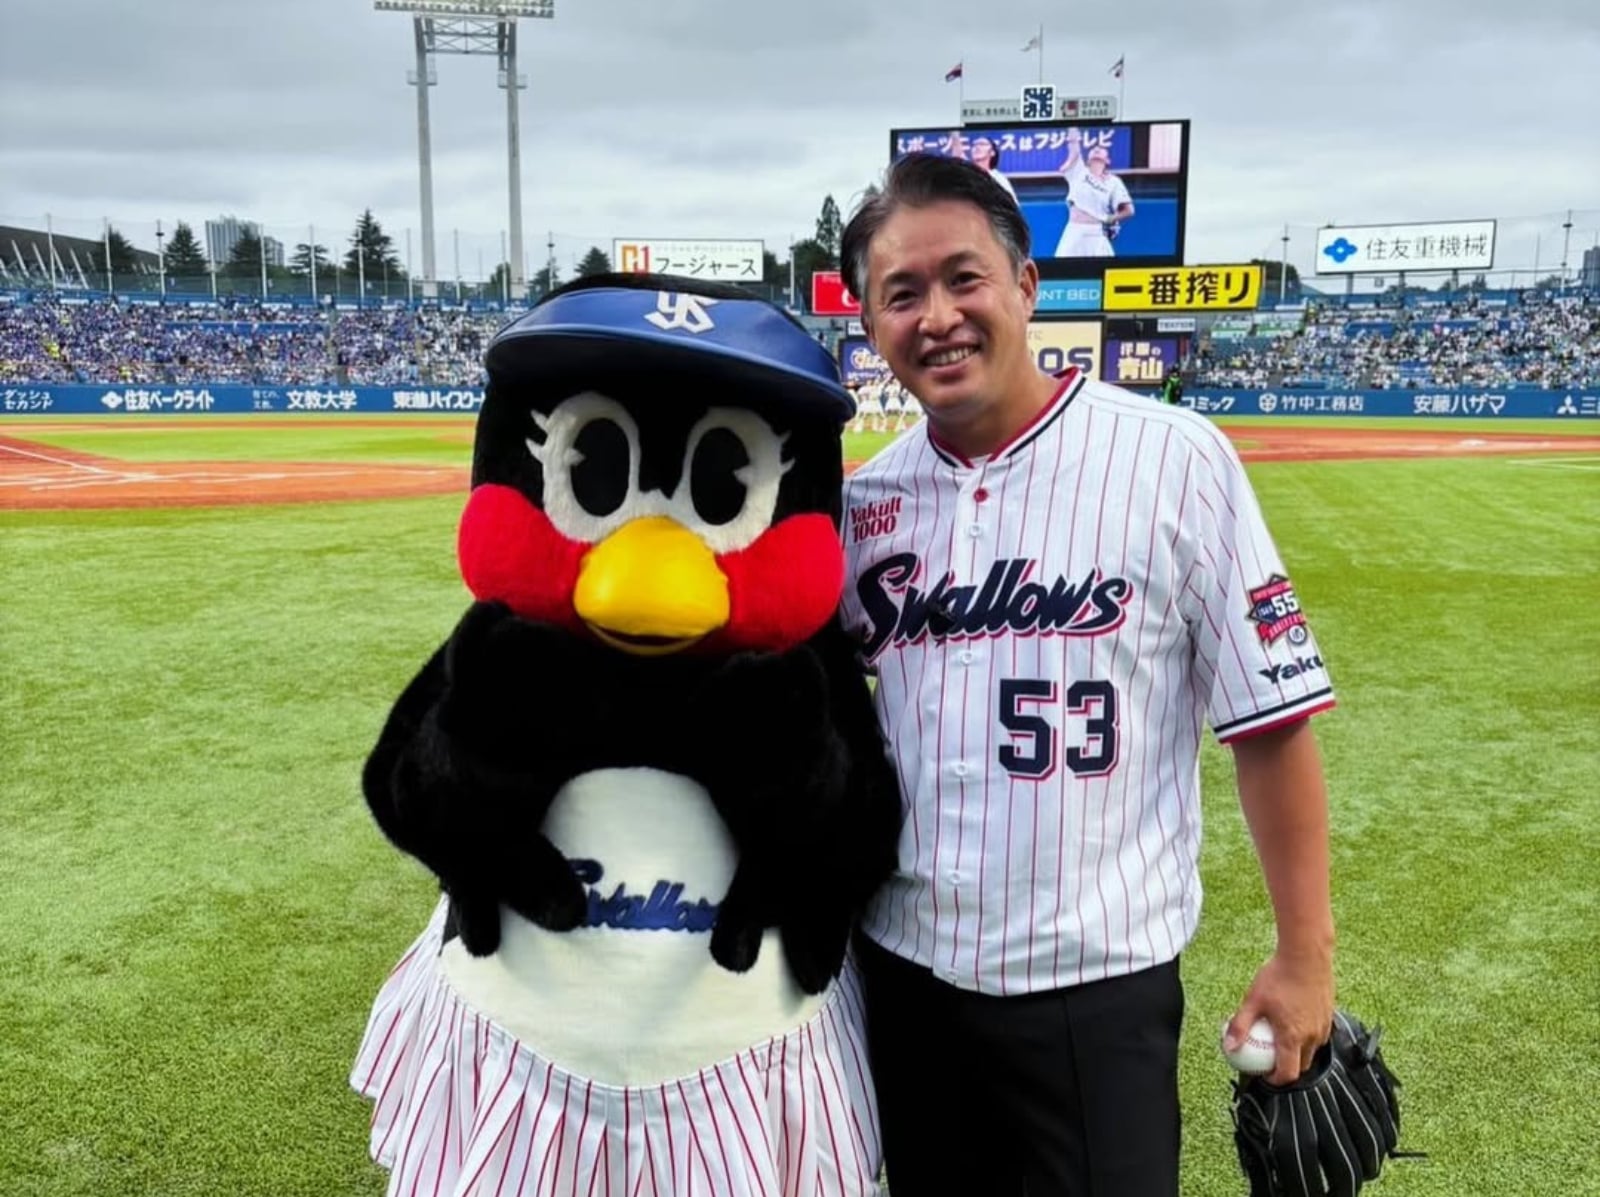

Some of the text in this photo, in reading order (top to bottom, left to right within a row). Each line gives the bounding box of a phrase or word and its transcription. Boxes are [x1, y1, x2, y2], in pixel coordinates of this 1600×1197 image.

[1366, 234, 1487, 260] 住友重機械
[655, 254, 757, 275] フージャース
[1113, 270, 1250, 305] 一番搾り
[1117, 357, 1163, 380] 青山
[124, 389, 215, 411] 住友ベークライト
[286, 390, 358, 410] 文教大学
[393, 390, 486, 409] 東進ハイスクー
[1281, 395, 1364, 412] 竹中工務店
[1413, 393, 1506, 414] 安藤ハザマ
[850, 496, 902, 525] Yakult
[853, 515, 897, 543] 1000
[857, 552, 1134, 664] Swallows
[1270, 590, 1299, 618] 55
[998, 678, 1120, 781] 53
